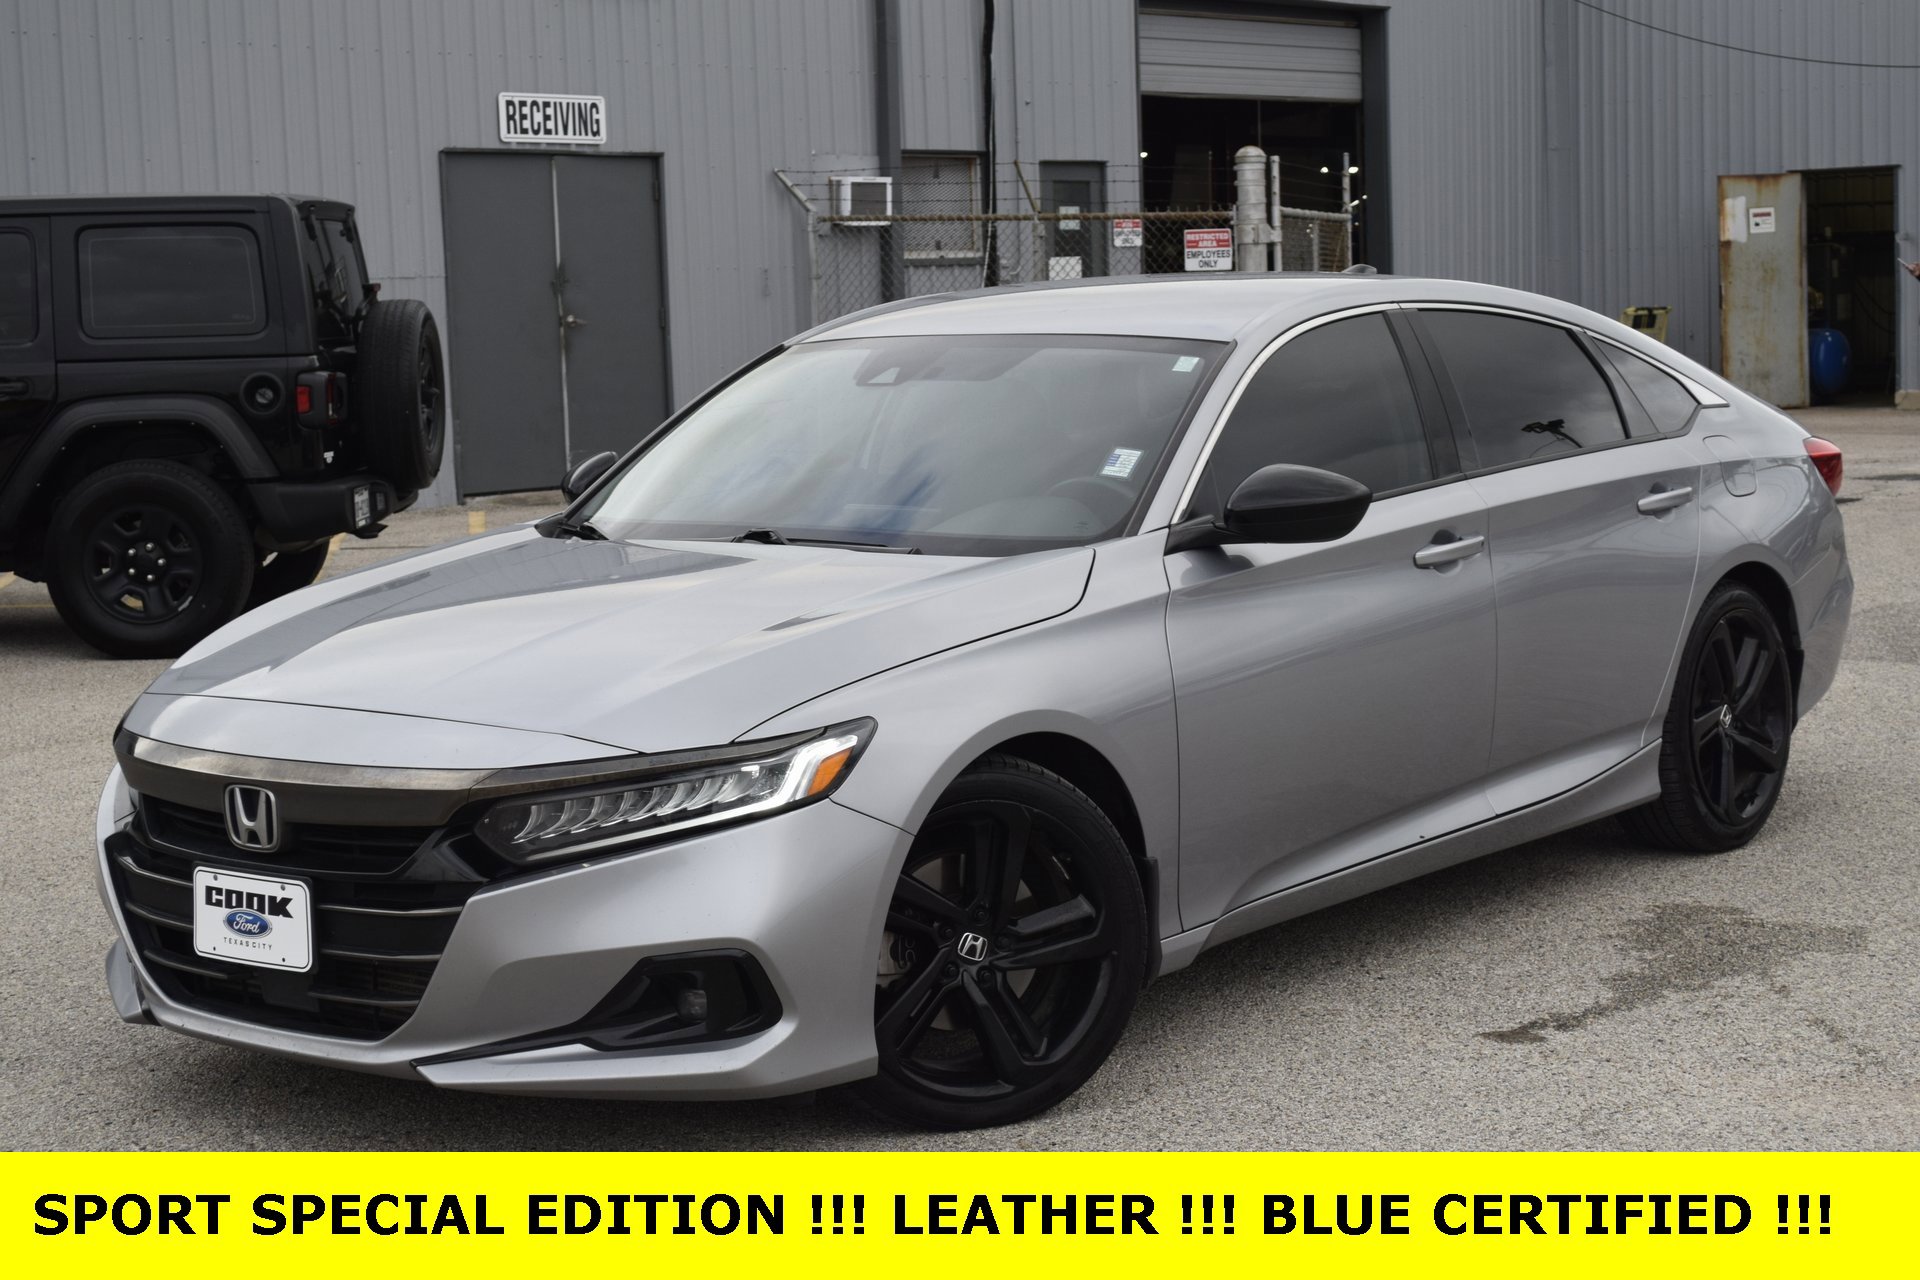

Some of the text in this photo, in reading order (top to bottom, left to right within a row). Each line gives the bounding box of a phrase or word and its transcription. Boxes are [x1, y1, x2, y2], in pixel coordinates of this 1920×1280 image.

[505, 99, 601, 137] RECEIVING
[1186, 250, 1231, 259] EMPLOYEES
[1198, 260, 1218, 268] ONLY
[205, 885, 294, 919] COOK
[233, 913, 260, 934] Ford
